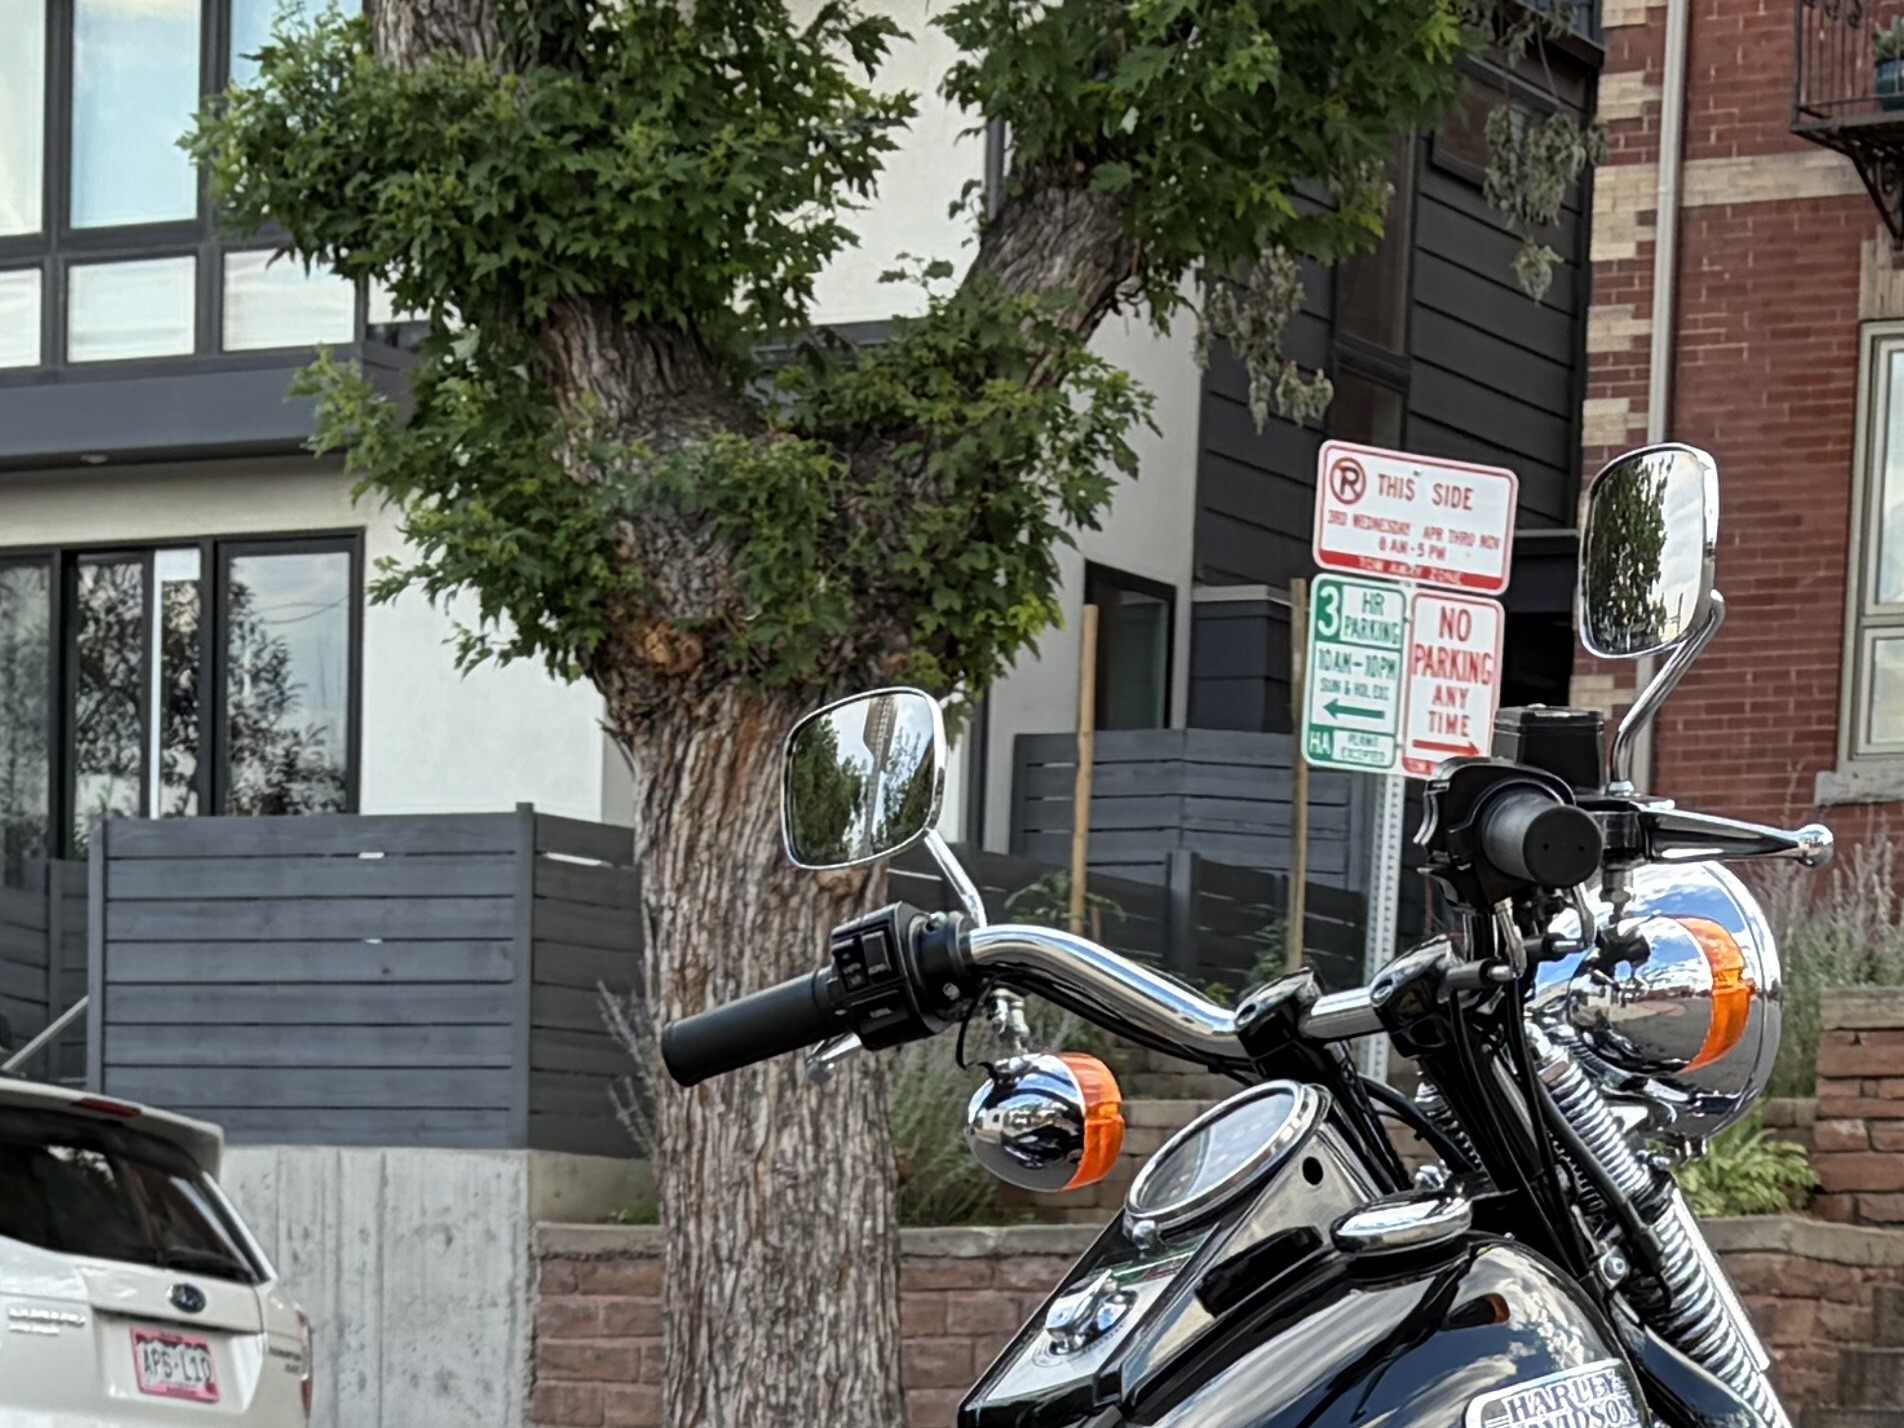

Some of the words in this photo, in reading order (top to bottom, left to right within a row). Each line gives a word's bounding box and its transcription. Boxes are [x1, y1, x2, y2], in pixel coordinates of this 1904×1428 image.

[1378, 473, 1416, 501] THIS
[1432, 482, 1474, 511] SIDE
[1353, 513, 1411, 536] WEDNESDAY
[1423, 526, 1443, 542] APR
[1317, 585, 1339, 636] 3
[1362, 591, 1385, 616] HR
[1344, 615, 1399, 645] PARKING
[1438, 605, 1472, 642] NO
[1412, 643, 1493, 685] PARKING
[1320, 677, 1341, 693] SUN
[1431, 683, 1469, 710] ANY
[1428, 710, 1470, 737] TIME
[1309, 731, 1331, 755] HA
[1504, 1369, 1617, 1423] HARLEY
